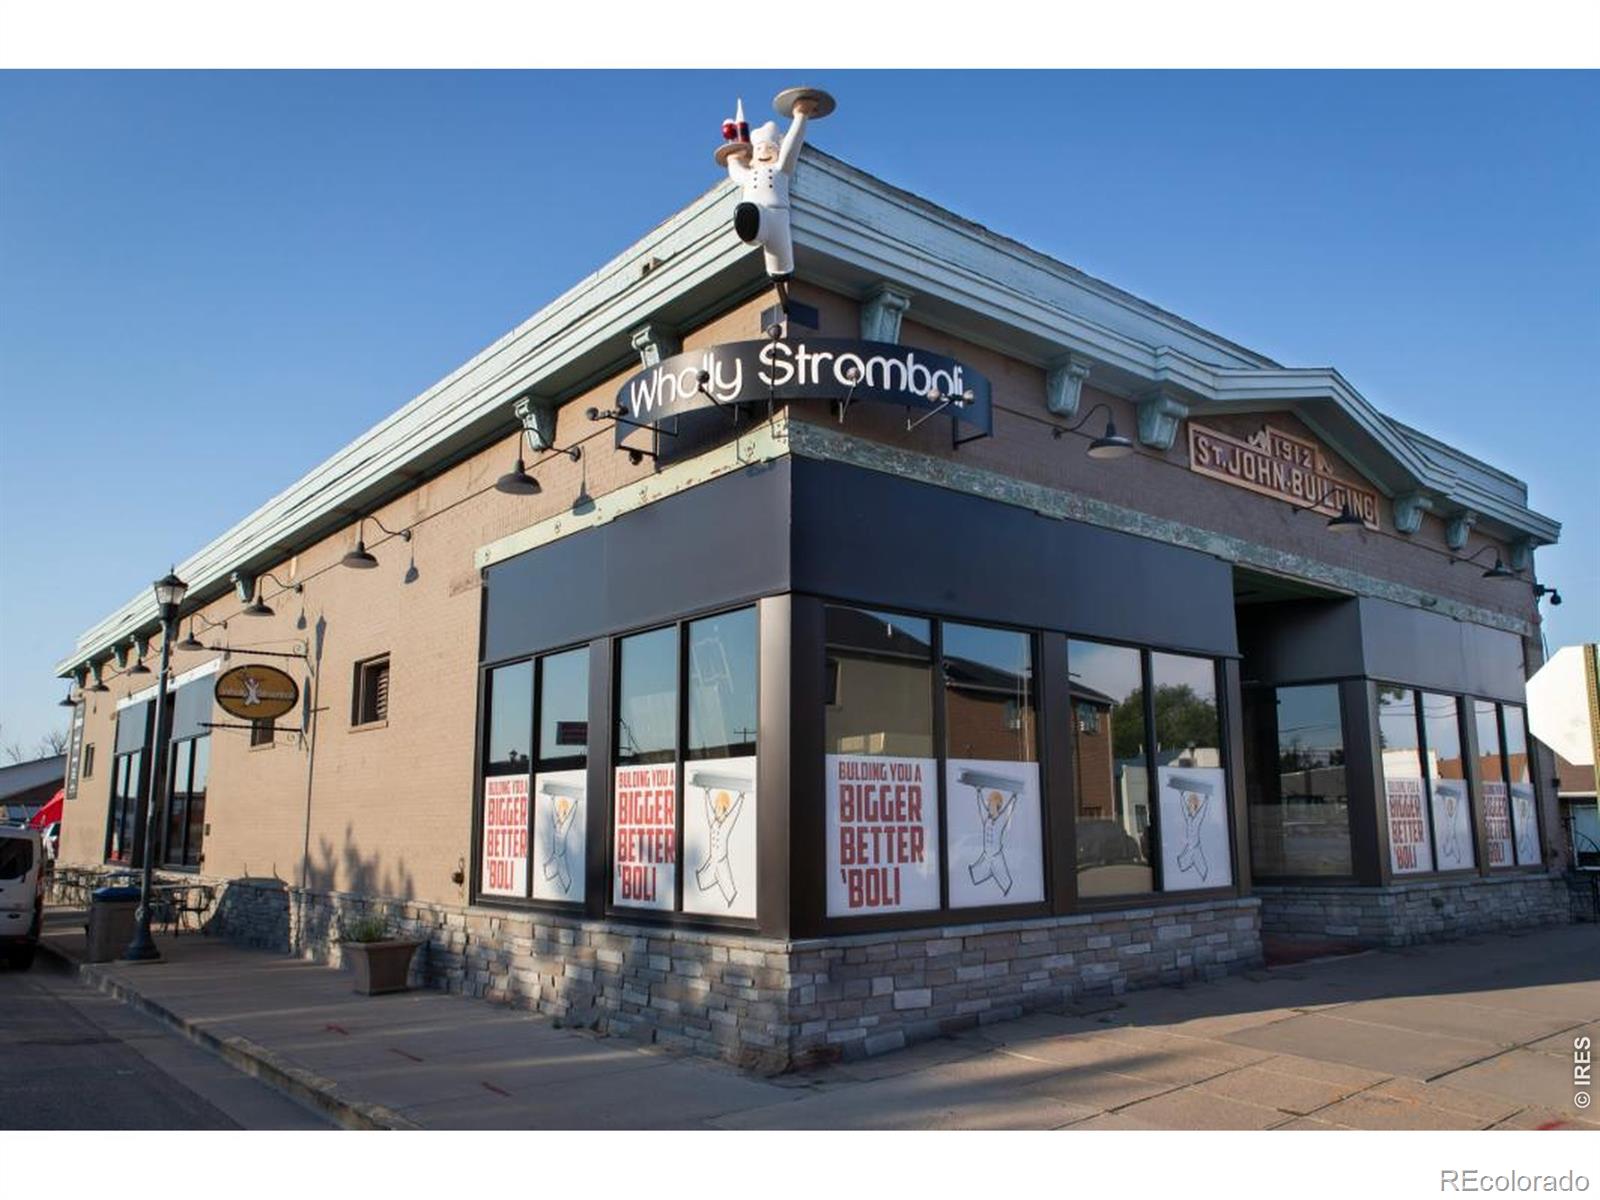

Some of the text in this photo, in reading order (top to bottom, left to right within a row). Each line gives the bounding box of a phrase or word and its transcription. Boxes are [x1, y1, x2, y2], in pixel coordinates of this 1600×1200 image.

[630, 342, 964, 419] Wholly Stromboli
[1274, 438, 1313, 469] 1912
[652, 768, 668, 787] YOU
[889, 762, 912, 782] YOU
[914, 763, 922, 782] A
[488, 797, 528, 827] BIGGER
[619, 789, 675, 825] BIGGER
[839, 784, 922, 822] BIGGER
[1389, 794, 1421, 819] BIGGER
[487, 828, 528, 858] BETTER
[618, 828, 676, 864] BETTER
[839, 826, 924, 865] BETTER
[1391, 819, 1424, 844] BETTER
